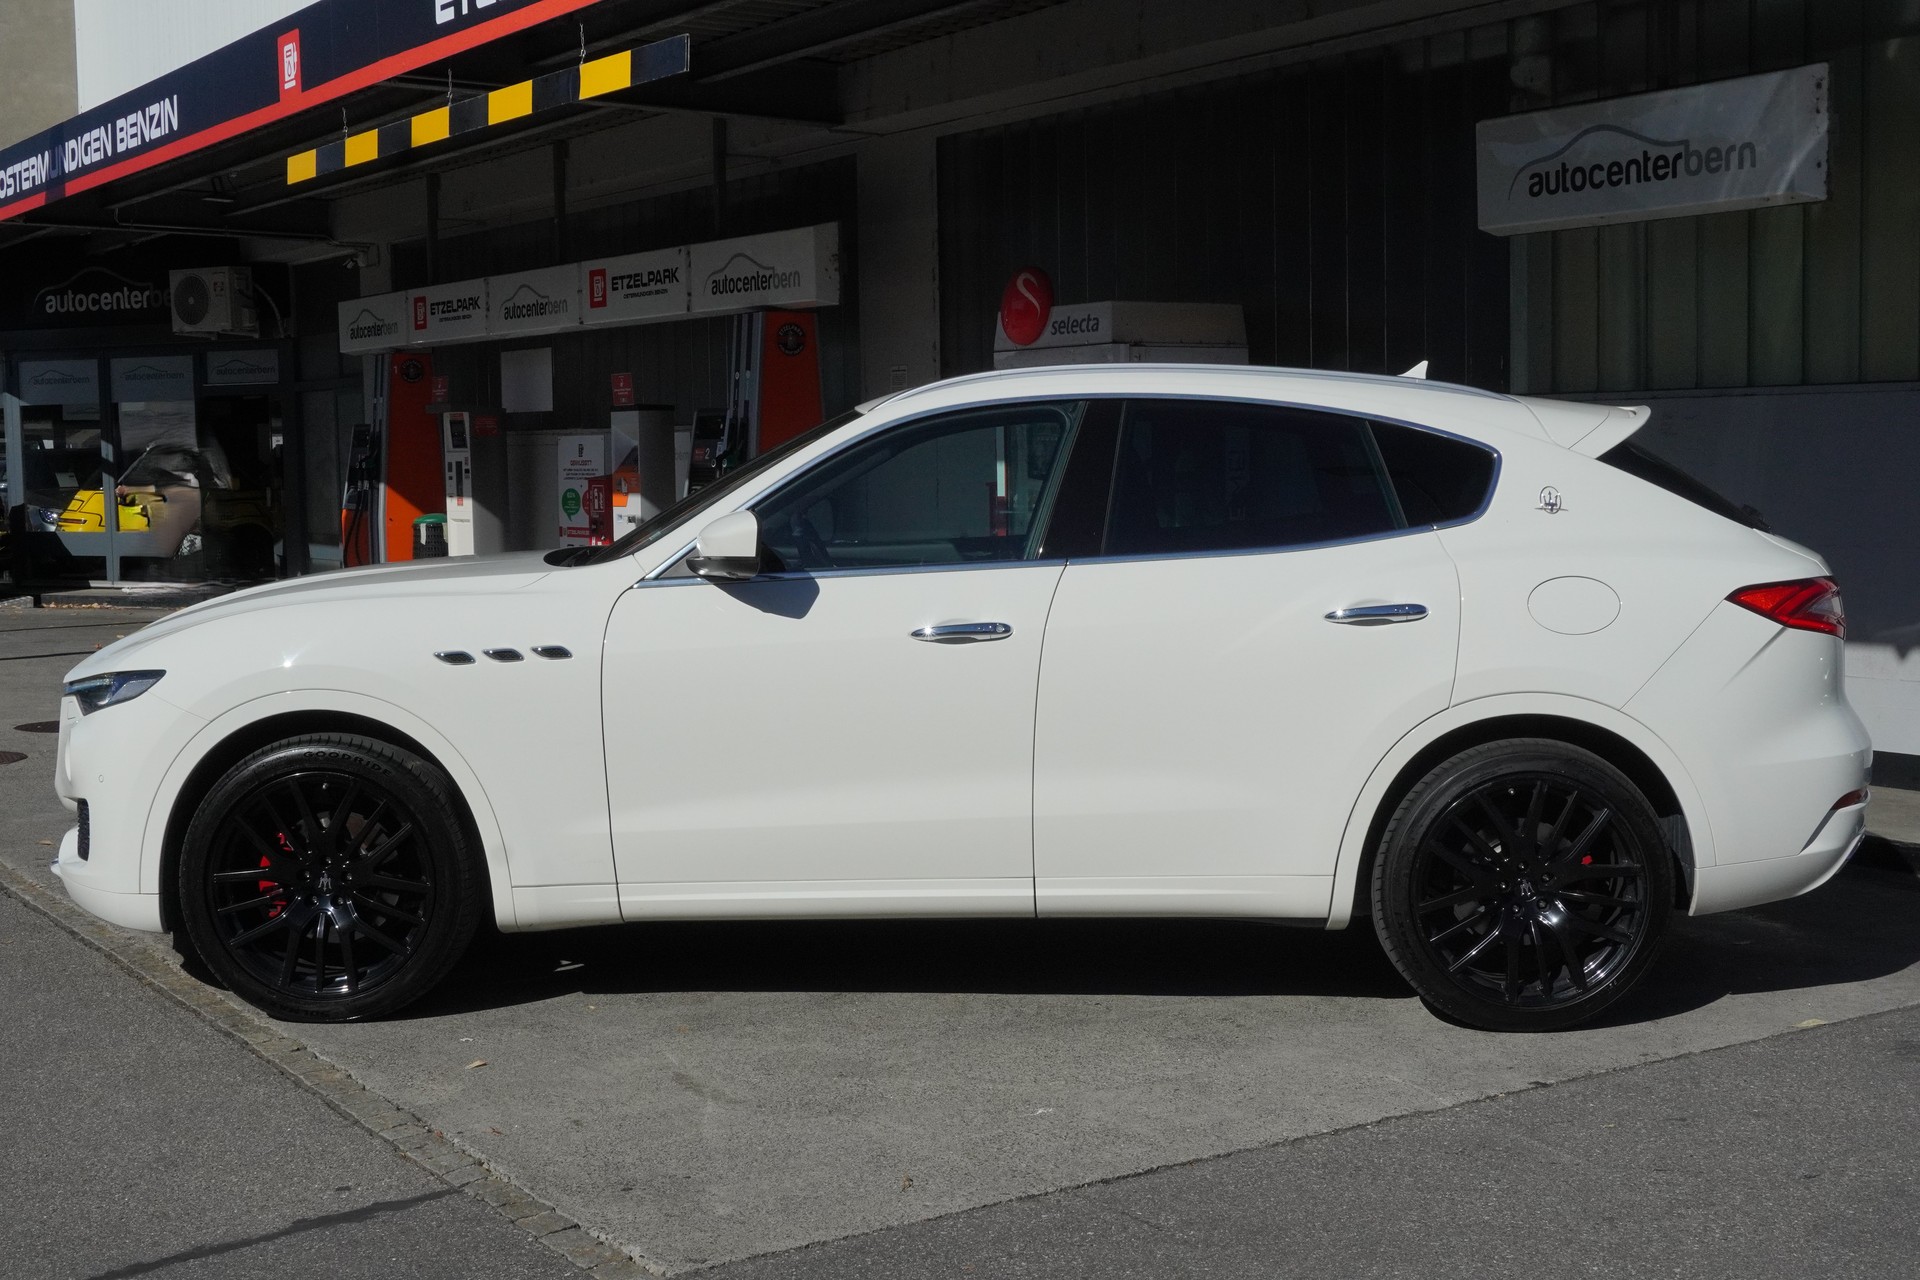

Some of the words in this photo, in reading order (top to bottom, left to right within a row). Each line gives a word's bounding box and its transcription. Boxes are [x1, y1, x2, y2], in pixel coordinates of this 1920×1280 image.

[116, 94, 178, 153] BENZIN
[1527, 140, 1757, 198] autocenterbern
[611, 266, 680, 291] ETZELPARK
[711, 267, 801, 296] autocenterbern
[45, 285, 171, 314] autocenterbe
[430, 295, 481, 316] ETZELPARK
[503, 297, 568, 321] autocenterbern
[349, 318, 398, 340] autocenterbern
[1050, 313, 1099, 336] selecta
[216, 364, 276, 376] autocenterbern
[704, 447, 710, 460] 2
[303, 750, 393, 777] GOODRIDE
